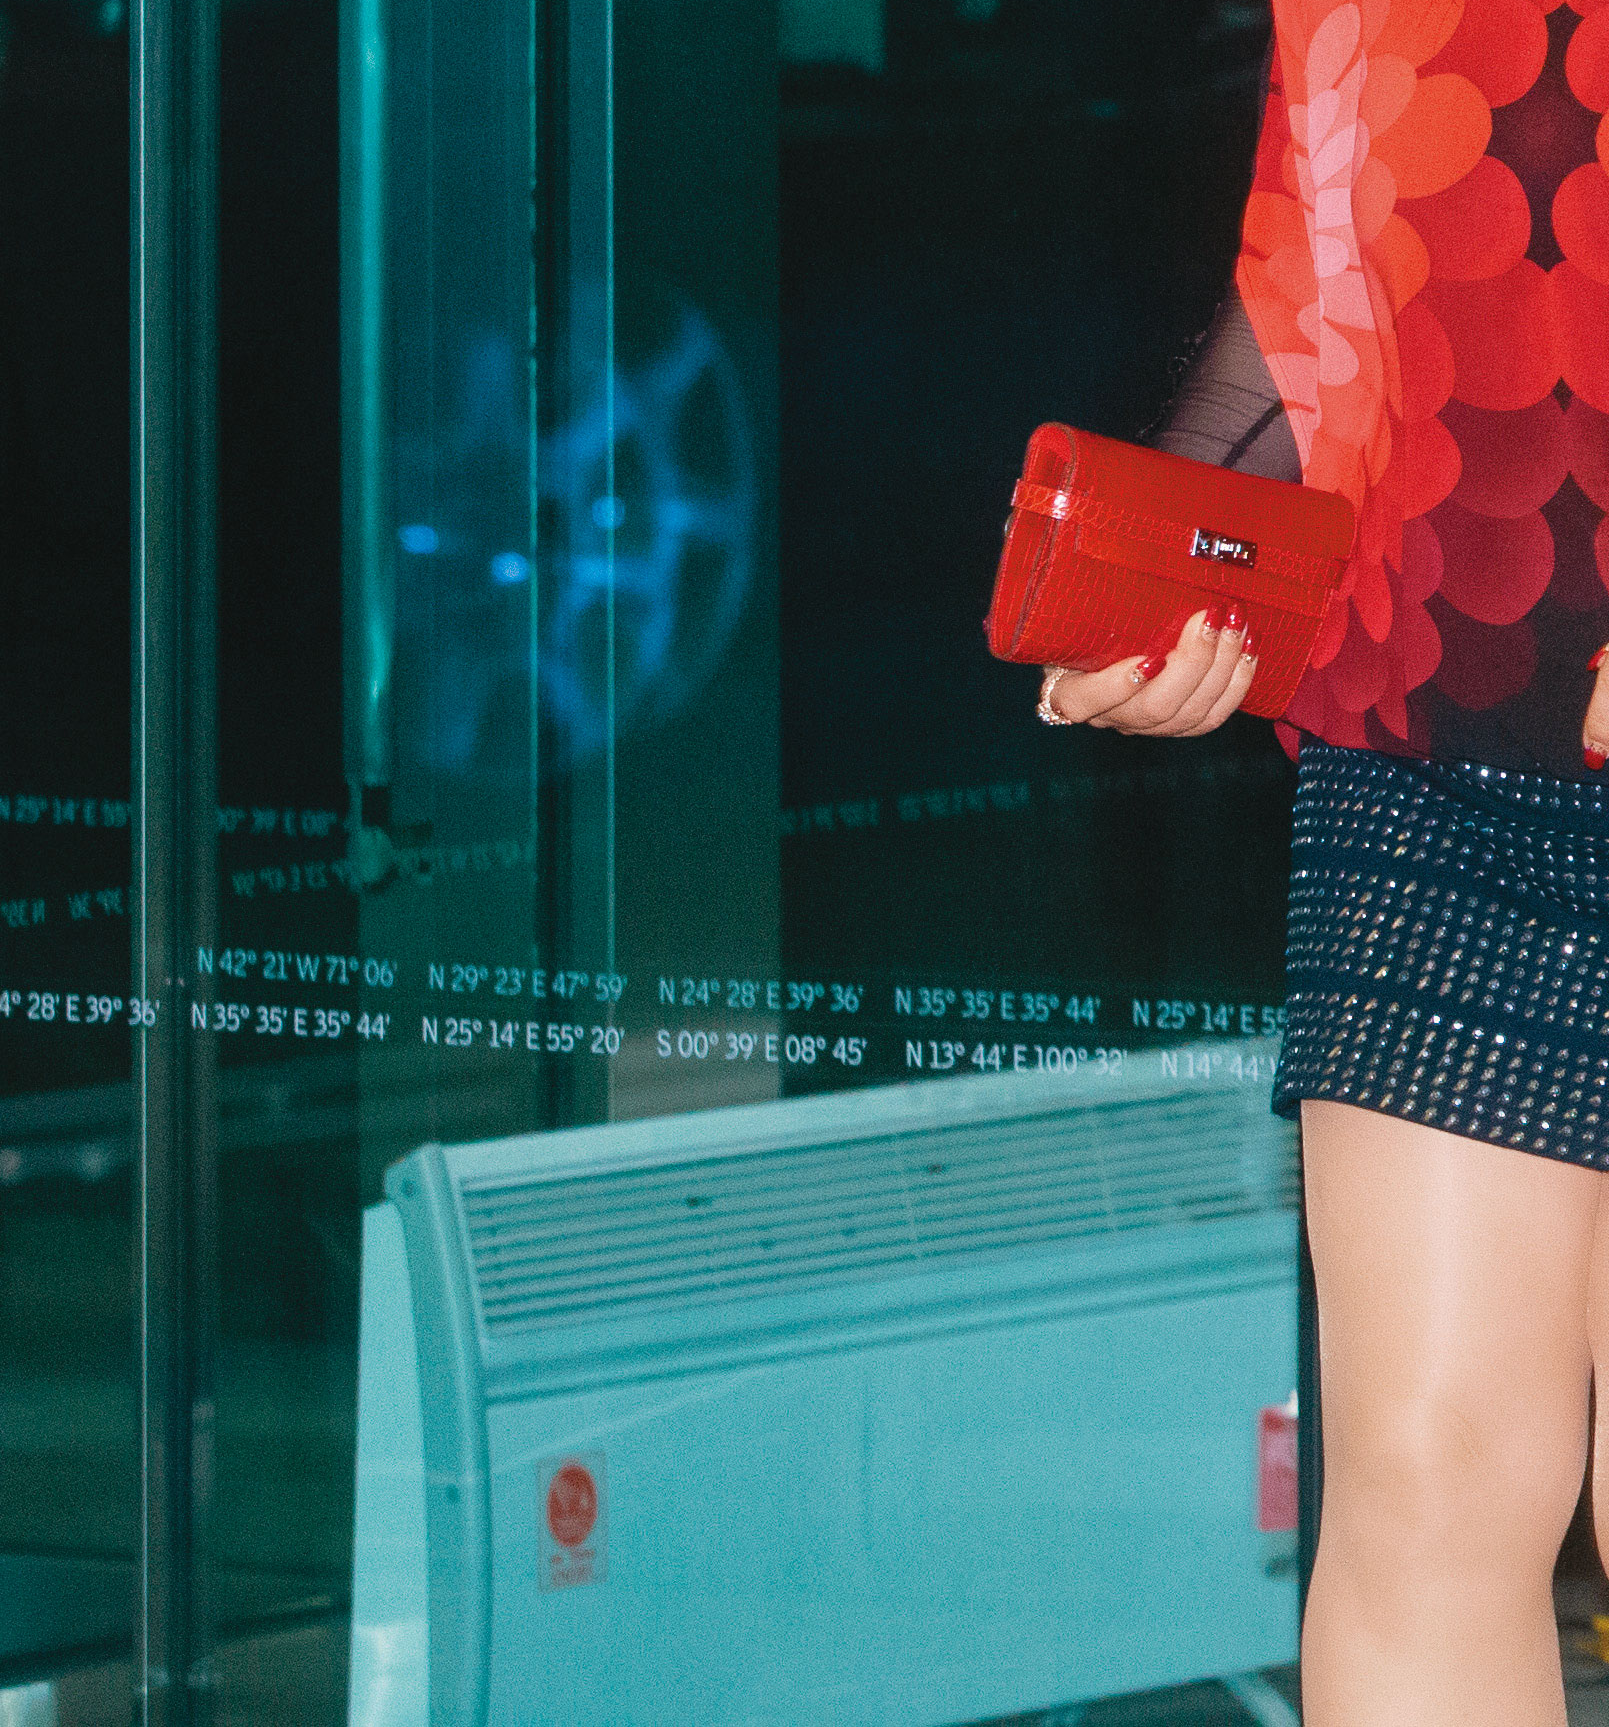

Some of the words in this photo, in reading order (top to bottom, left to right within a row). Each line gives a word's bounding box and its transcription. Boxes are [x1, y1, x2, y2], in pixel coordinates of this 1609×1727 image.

[198, 946, 213, 974] N
[263, 950, 291, 981] 21'
[296, 953, 320, 981] W
[364, 957, 398, 987] 06'
[428, 963, 444, 990] N
[494, 967, 526, 996] 23'
[532, 969, 546, 997] E
[596, 973, 628, 1001] 59'
[659, 977, 675, 1004] N
[726, 979, 760, 1008] 28'
[766, 980, 781, 1010] E
[830, 983, 863, 1013] 36'
[895, 986, 911, 1015] N
[961, 988, 994, 1019] 35'
[1000, 991, 1015, 1021] E
[1065, 995, 1100, 1024] 44'
[1132, 998, 1149, 1027] N
[1200, 1002, 1235, 1031] 14'
[1240, 1004, 1255, 1033] E
[27, 991, 59, 1021] 28'
[66, 994, 80, 1022] E
[128, 996, 160, 1026] 36'
[191, 1001, 207, 1030] N
[255, 1005, 287, 1035] 35'
[294, 1007, 308, 1036] E
[356, 1011, 390, 1040] 44'
[422, 1016, 437, 1044] N
[489, 1020, 519, 1048] 14'
[526, 1021, 540, 1051] E
[591, 1025, 625, 1055] 20'
[656, 1029, 672, 1058] S
[725, 1031, 758, 1060] 39'
[765, 1033, 779, 1062] E
[832, 1036, 867, 1066] 45'
[906, 1040, 922, 1069] N
[971, 1042, 1007, 1071] 44'
[1014, 1044, 1027, 1073] E
[1095, 1046, 1127, 1075] 32'
[1161, 1051, 1177, 1077] N
[1230, 1055, 1264, 1081] 44'
